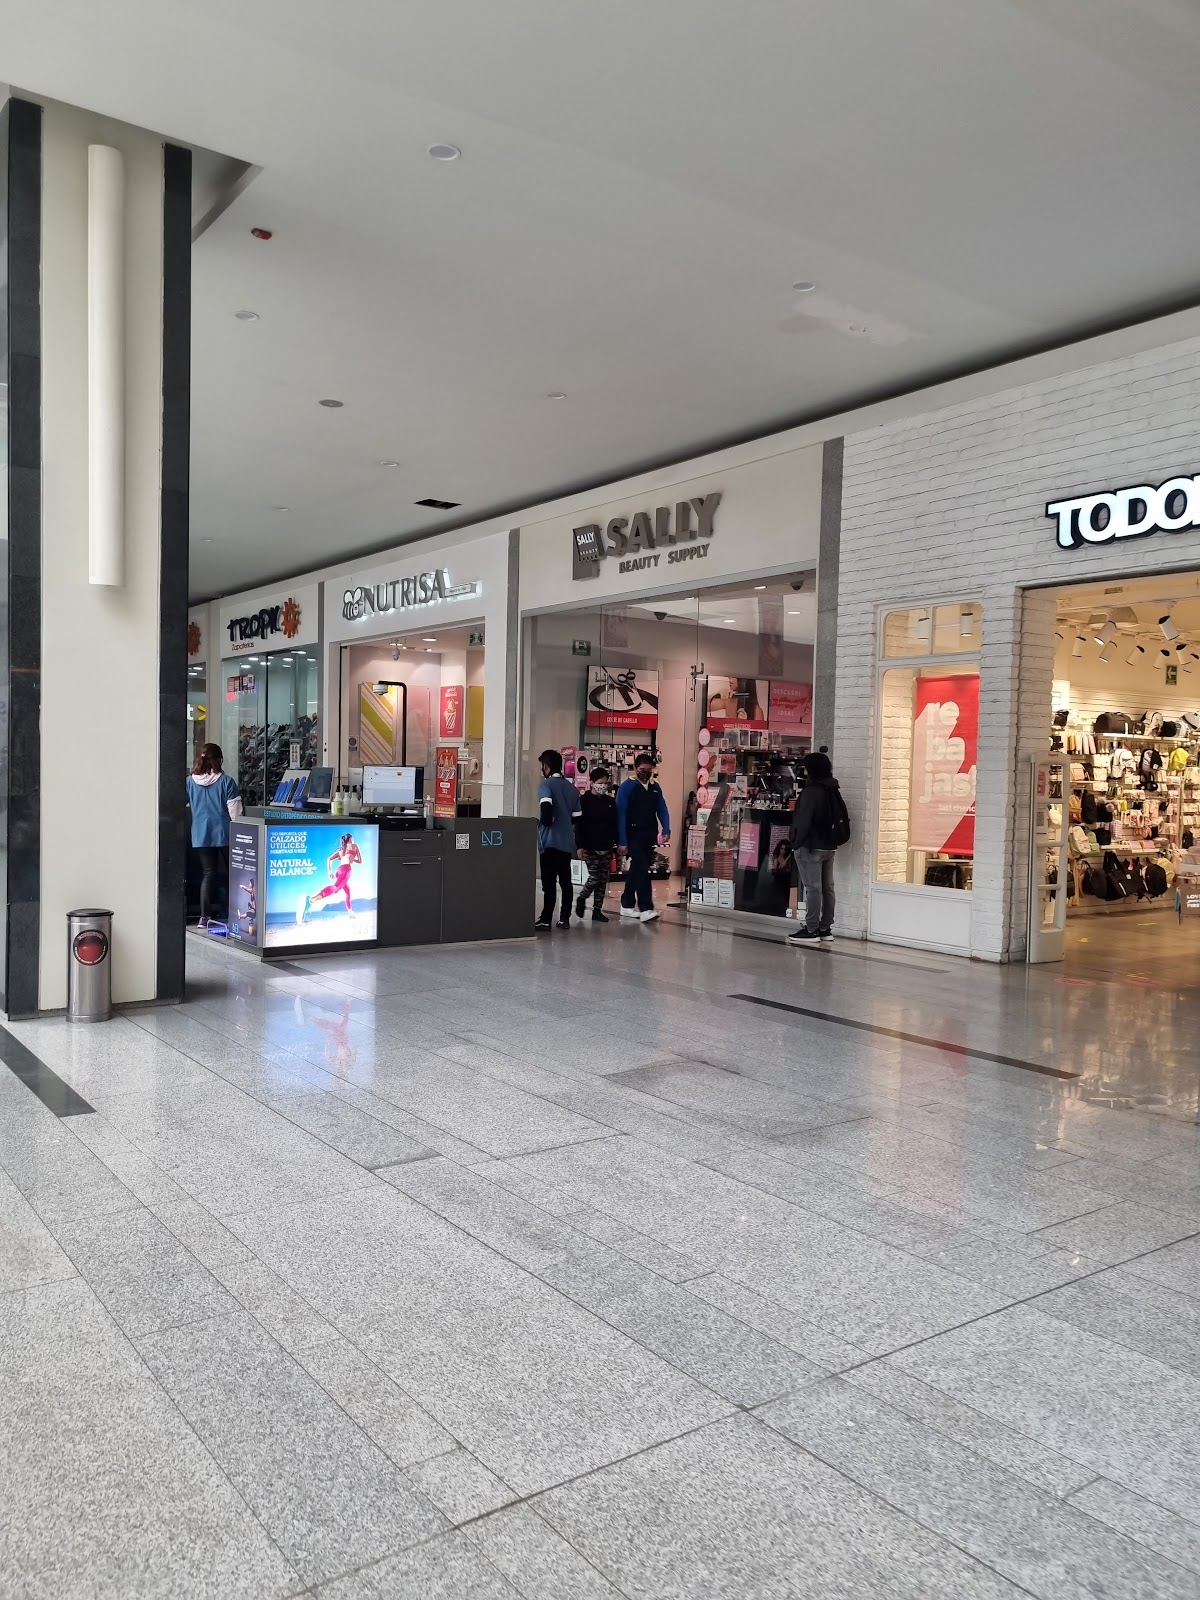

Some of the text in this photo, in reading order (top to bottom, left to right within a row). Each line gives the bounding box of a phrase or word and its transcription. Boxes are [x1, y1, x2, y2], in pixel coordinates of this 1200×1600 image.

[1047, 474, 1200, 547] TODO
[606, 492, 722, 557] SALLY
[577, 532, 595, 546] SALLY
[579, 548, 598, 556] BEAUTY
[618, 543, 710, 573] BEAUTY SUPPLY
[362, 569, 447, 614] NUTRISA
[926, 701, 960, 726] re
[925, 729, 965, 761] ba
[270, 835, 307, 843] CALZADO
[269, 858, 313, 868] NATURAL
